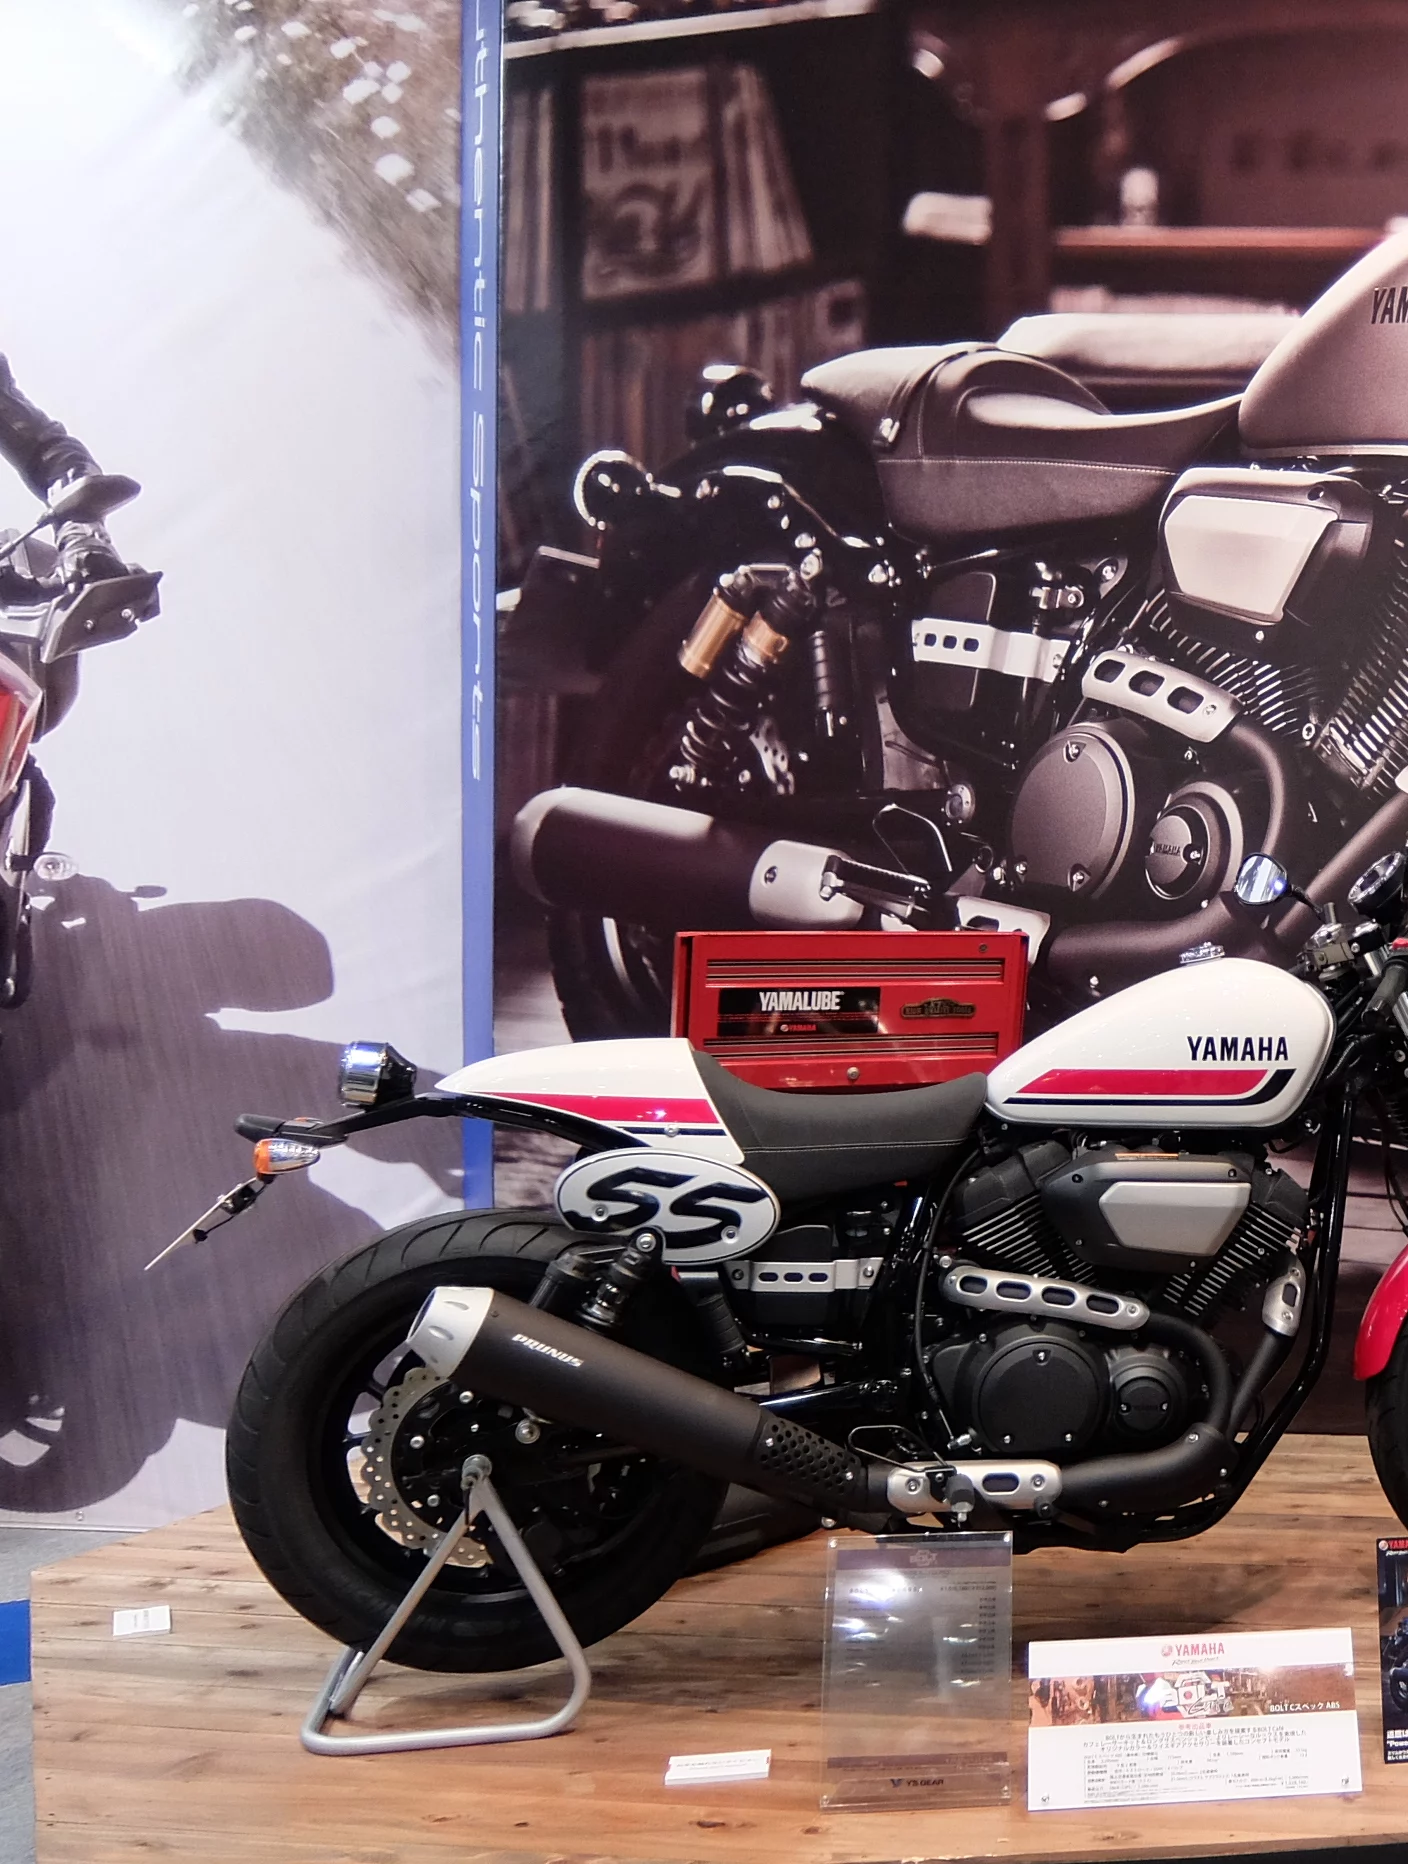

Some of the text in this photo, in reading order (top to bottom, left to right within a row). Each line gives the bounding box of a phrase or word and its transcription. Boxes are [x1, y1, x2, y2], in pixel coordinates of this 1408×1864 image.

[470, 411, 485, 781] Sports
[759, 991, 841, 1011] YAMALUBE
[1186, 1036, 1289, 1061] YAMAHA
[1175, 1642, 1225, 1657] YAMAHA
[1269, 1704, 1289, 1713] BOLT
[1326, 1701, 1341, 1710] ABS
[920, 1779, 944, 1787] GEAR
